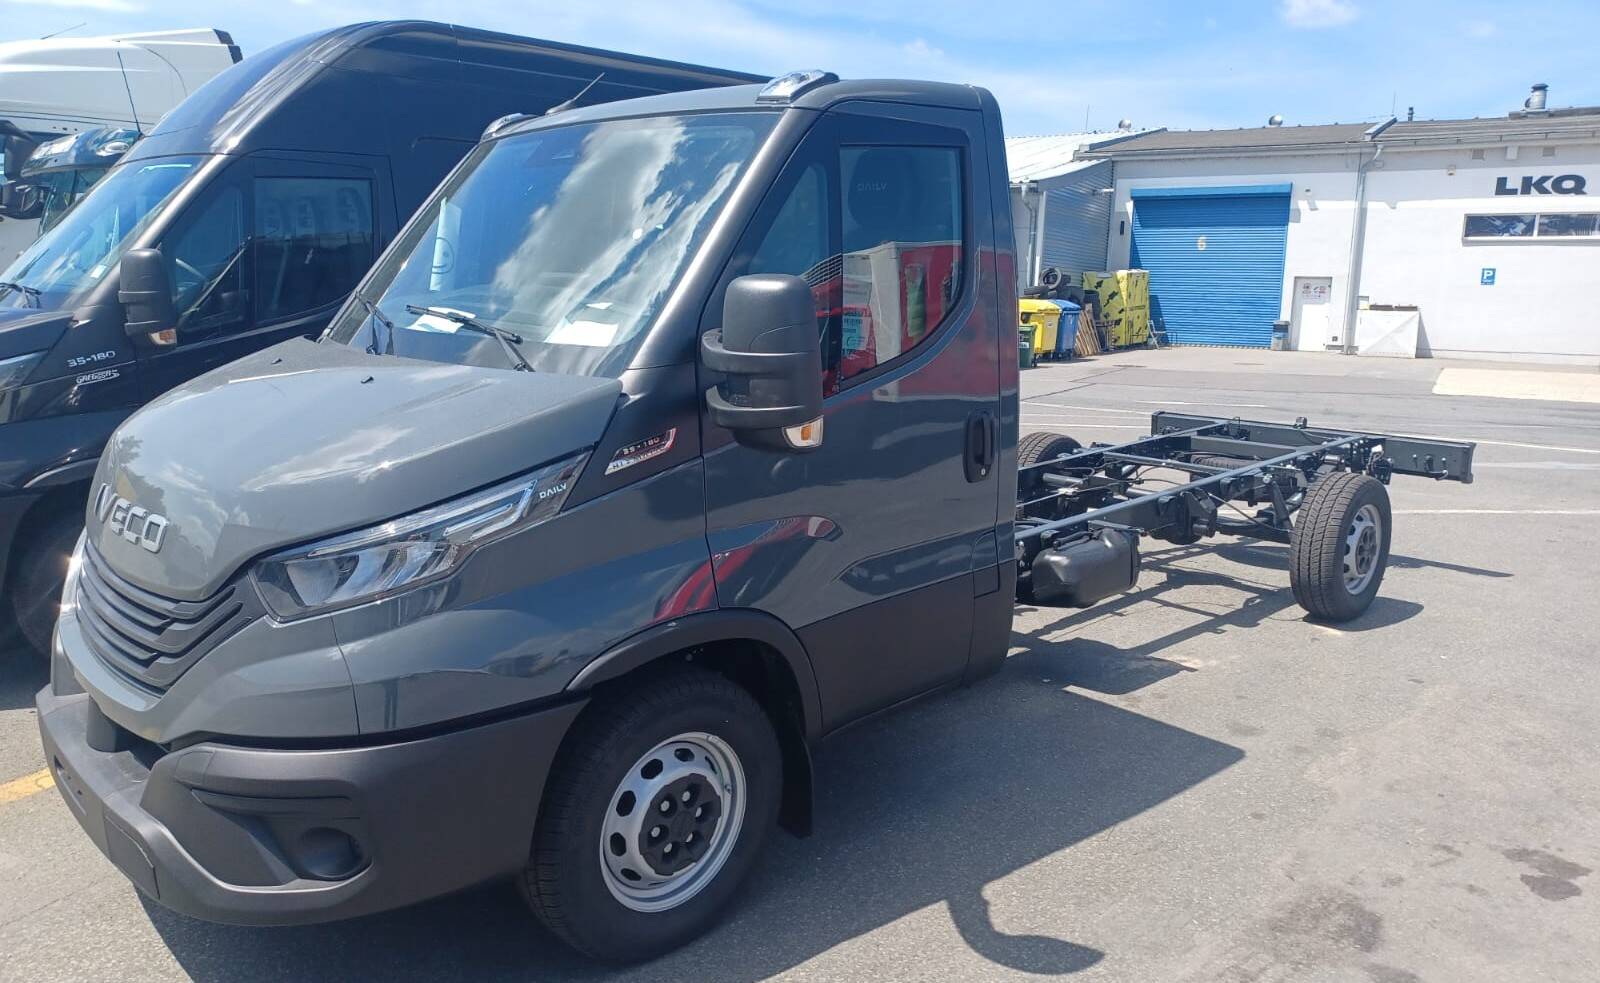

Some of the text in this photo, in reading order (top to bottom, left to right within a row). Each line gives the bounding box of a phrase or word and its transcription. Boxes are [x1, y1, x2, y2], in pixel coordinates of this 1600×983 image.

[1495, 174, 1587, 196] LKQ
[67, 350, 116, 367] 35-180
[539, 482, 567, 499] DAILY
[94, 483, 169, 553] IVECO
